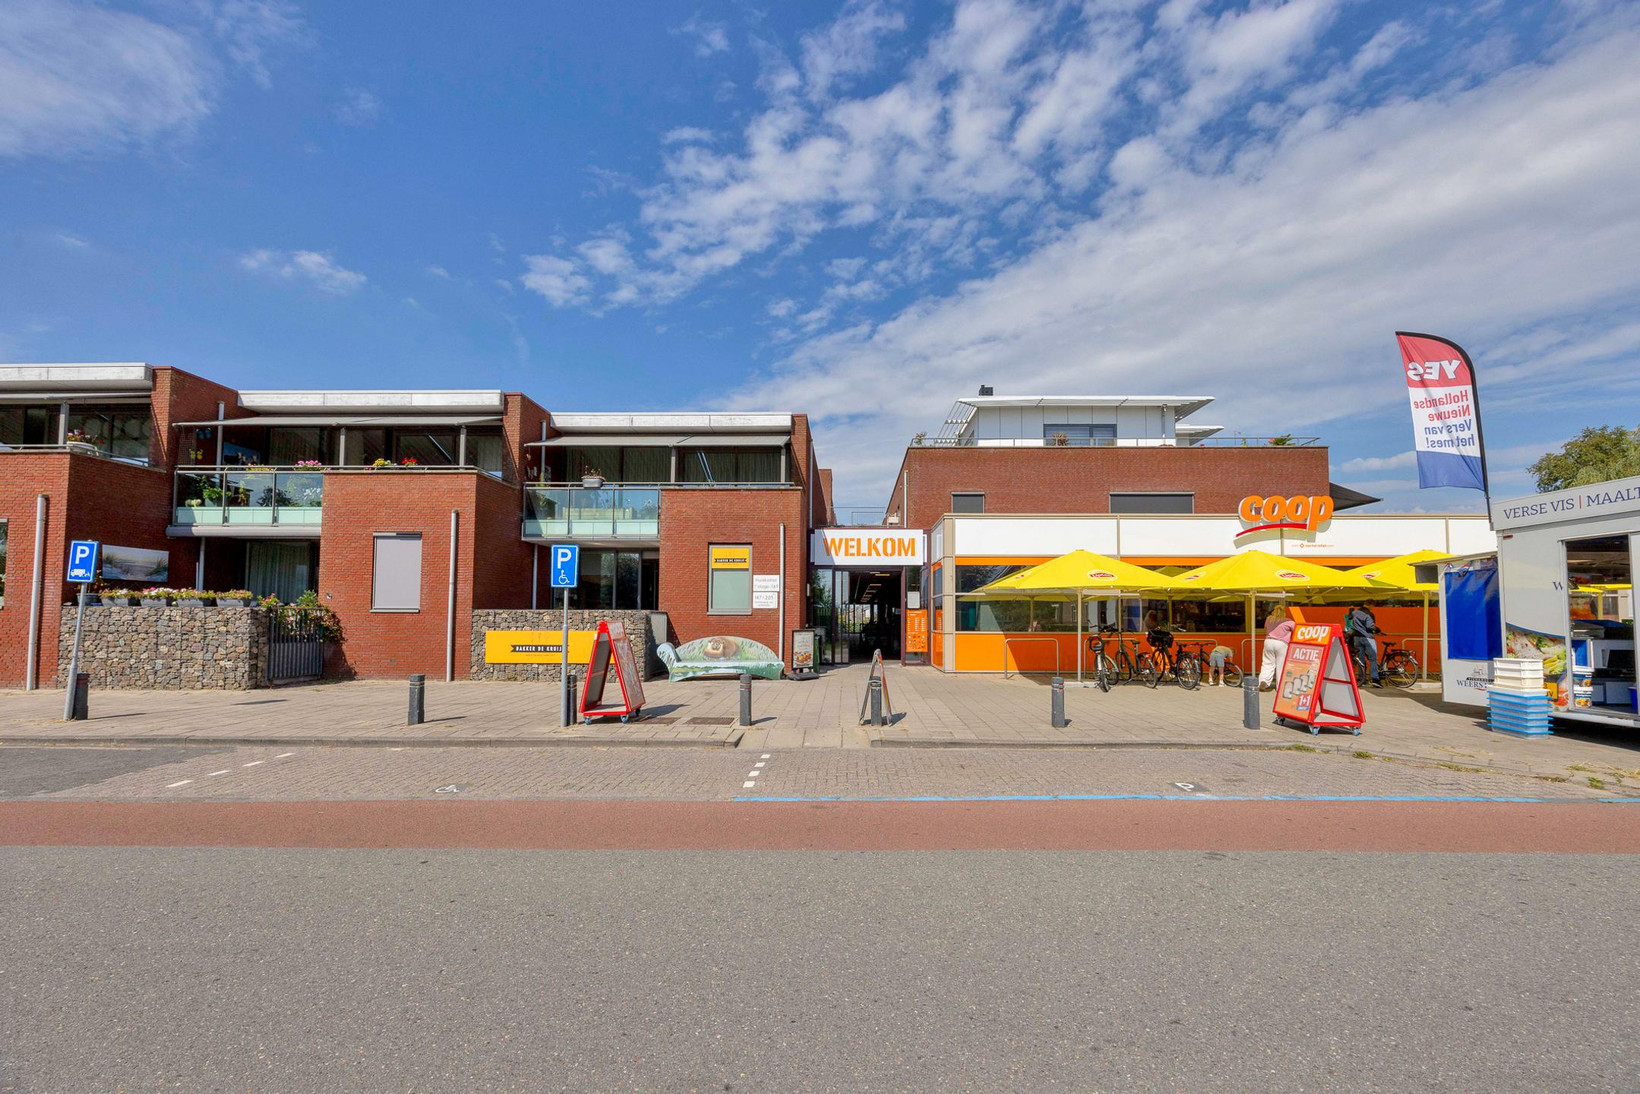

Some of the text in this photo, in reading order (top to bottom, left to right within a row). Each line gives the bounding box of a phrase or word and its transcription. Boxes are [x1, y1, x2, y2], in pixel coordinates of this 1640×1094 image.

[1239, 494, 1334, 532] coop
[1503, 503, 1548, 520] VERSE
[1550, 498, 1575, 512] VIS
[75, 545, 90, 565] P
[823, 537, 916, 557] WELKOM
[557, 548, 572, 569] P
[1297, 626, 1329, 642] coop
[1293, 648, 1320, 660] ACTIE
[1299, 694, 1311, 706] 1+1
